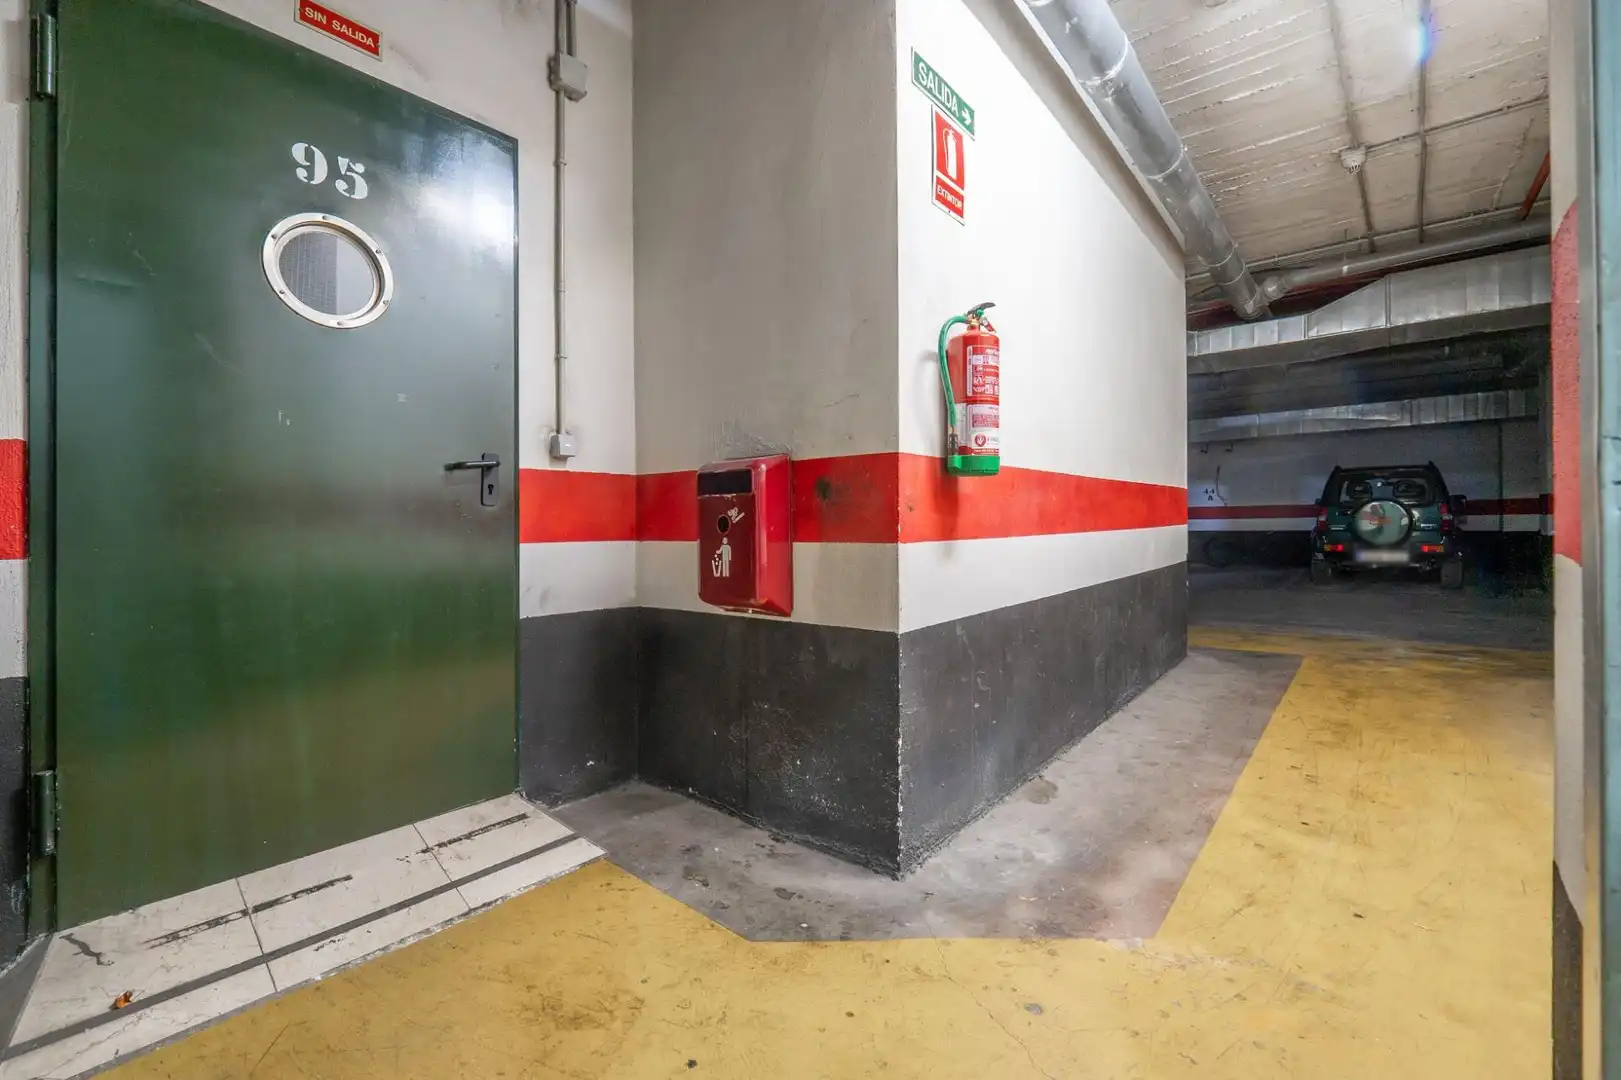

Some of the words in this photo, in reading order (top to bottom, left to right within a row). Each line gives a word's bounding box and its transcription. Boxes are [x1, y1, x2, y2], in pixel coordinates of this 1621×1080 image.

[304, 6, 327, 25] SIN
[331, 19, 375, 48] SALIDA
[918, 61, 959, 118] SALIDA
[291, 142, 368, 200] 95
[937, 184, 963, 209] EXTINTOR
